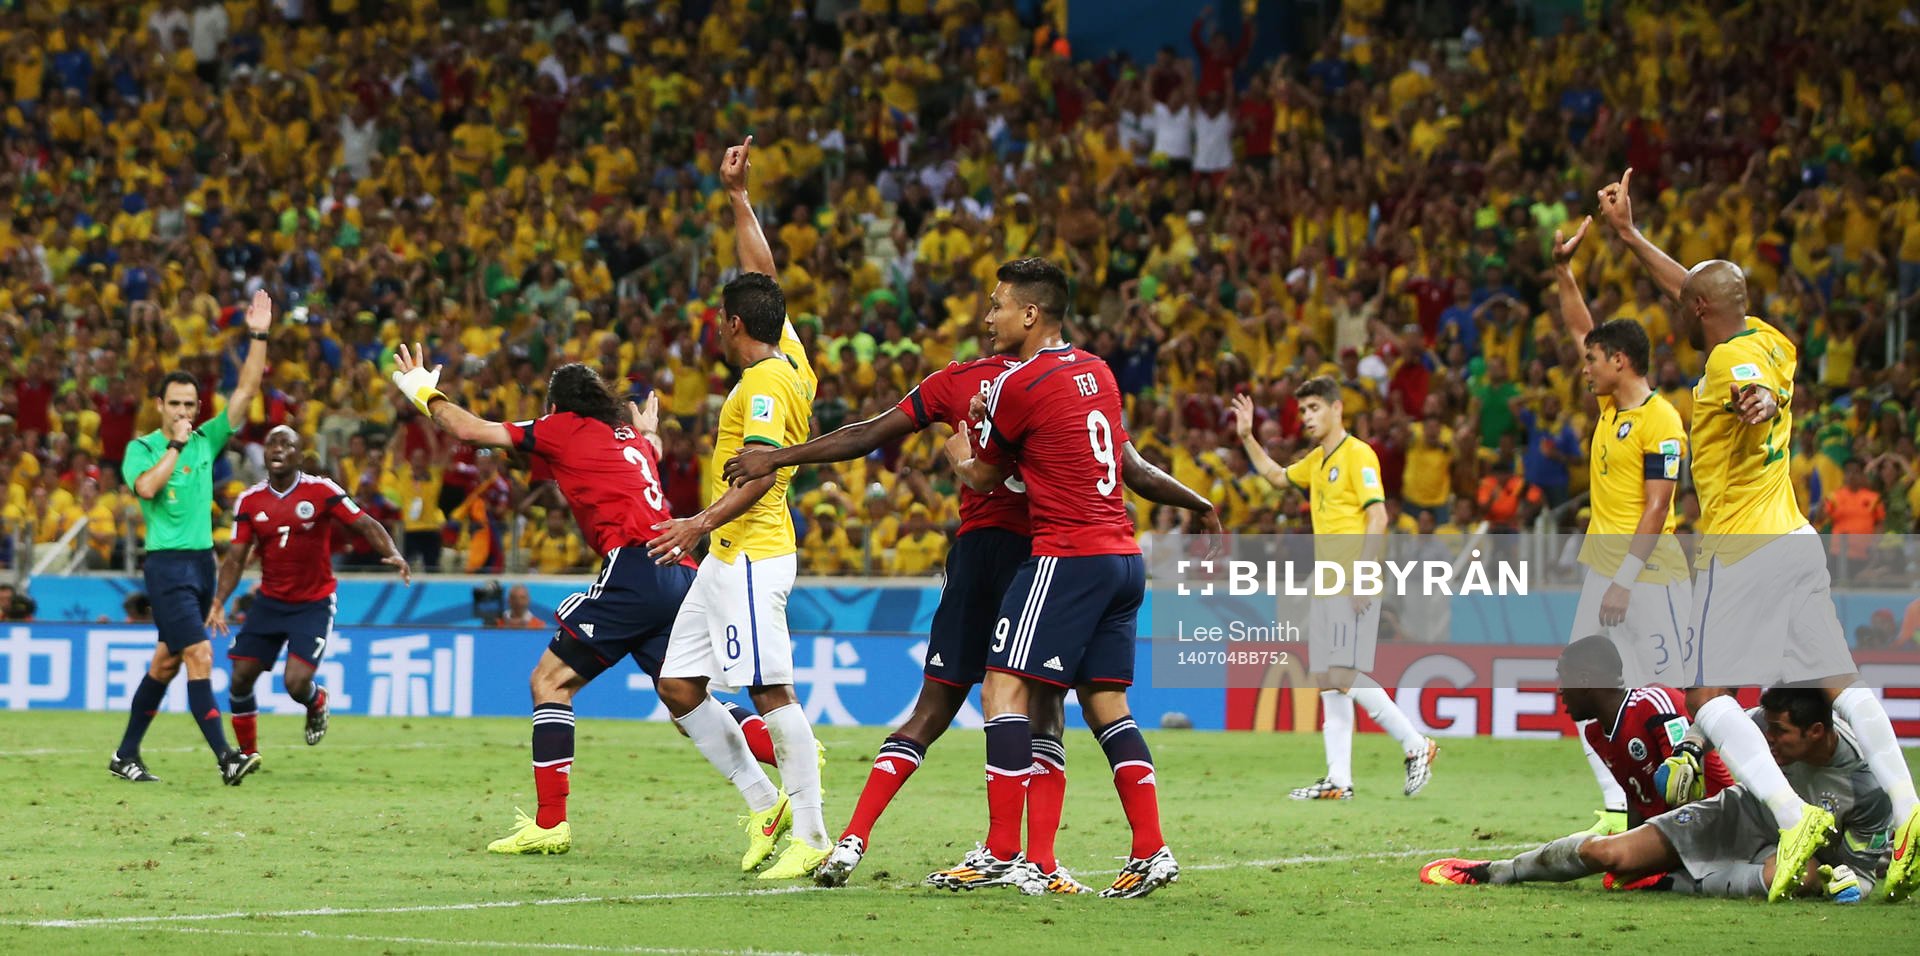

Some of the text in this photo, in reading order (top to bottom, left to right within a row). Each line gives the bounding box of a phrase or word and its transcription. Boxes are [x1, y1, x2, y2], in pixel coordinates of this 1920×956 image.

[1073, 372, 1099, 397] TEO
[1086, 409, 1117, 497] 9
[623, 446, 663, 511] 3
[277, 525, 291, 548] 7
[311, 636, 325, 659] 7
[726, 624, 741, 660] 8
[991, 617, 1011, 653] 9
[1649, 633, 1669, 666] 3
